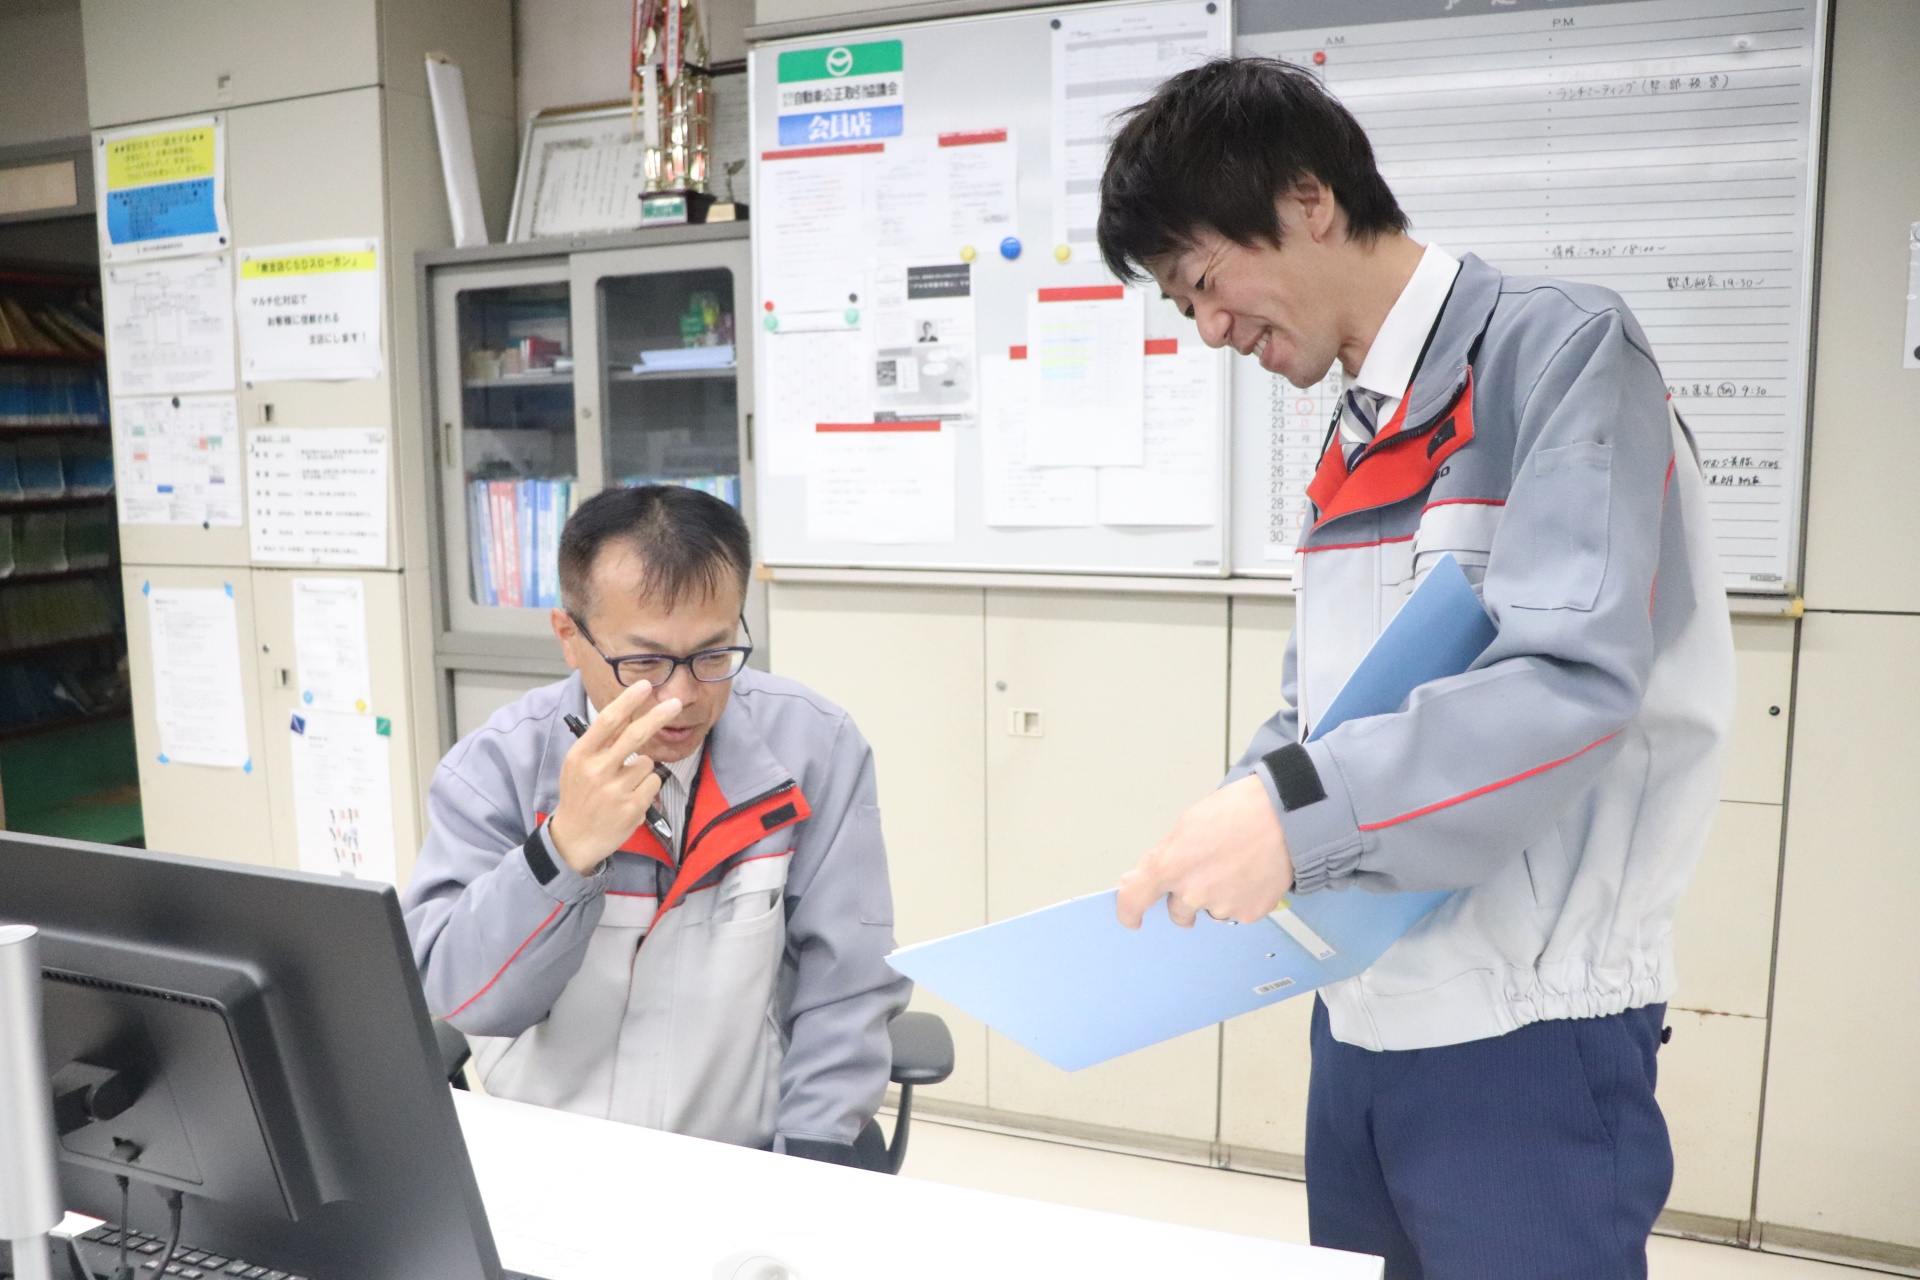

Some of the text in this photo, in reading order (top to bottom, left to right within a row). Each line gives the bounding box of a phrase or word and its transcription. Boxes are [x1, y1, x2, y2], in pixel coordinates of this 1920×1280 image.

[808, 111, 872, 142] 会員店
[1271, 385, 1284, 396] 21
[1271, 401, 1284, 412] 22
[1271, 416, 1284, 428] 23
[1271, 433, 1284, 444] 24
[1271, 449, 1284, 461] 25
[1270, 466, 1284, 477] 26
[1270, 482, 1284, 493] 27
[1270, 498, 1284, 510] 28
[1270, 514, 1283, 526] 29
[1269, 530, 1283, 542] 30
